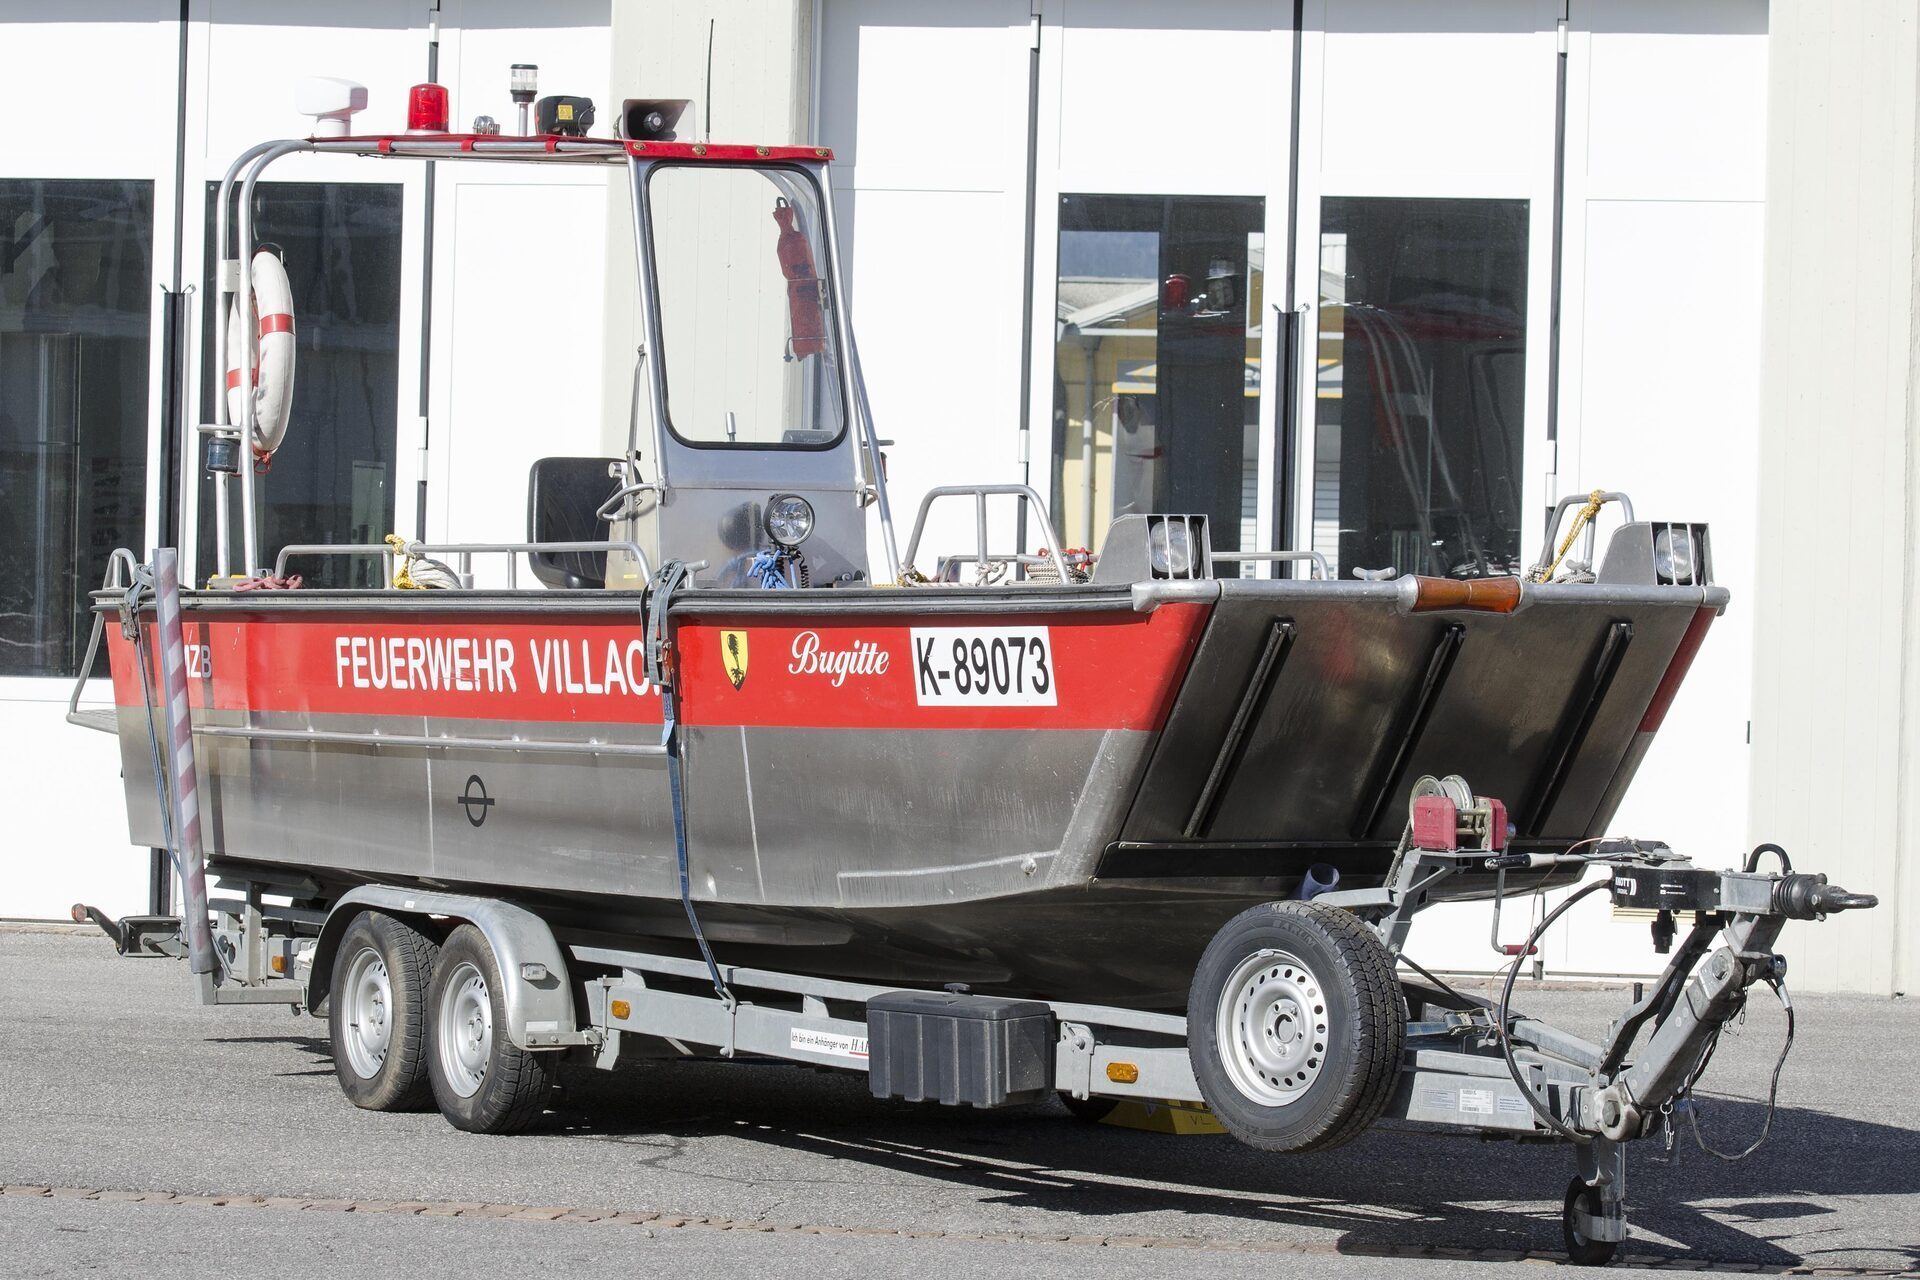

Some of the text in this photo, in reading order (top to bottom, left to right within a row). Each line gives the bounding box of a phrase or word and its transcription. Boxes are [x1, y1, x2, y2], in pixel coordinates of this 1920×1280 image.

[335, 636, 660, 696] FEUERWEHR VILLAC
[916, 636, 1050, 696] K-89073
[839, 1042, 848, 1050] von
